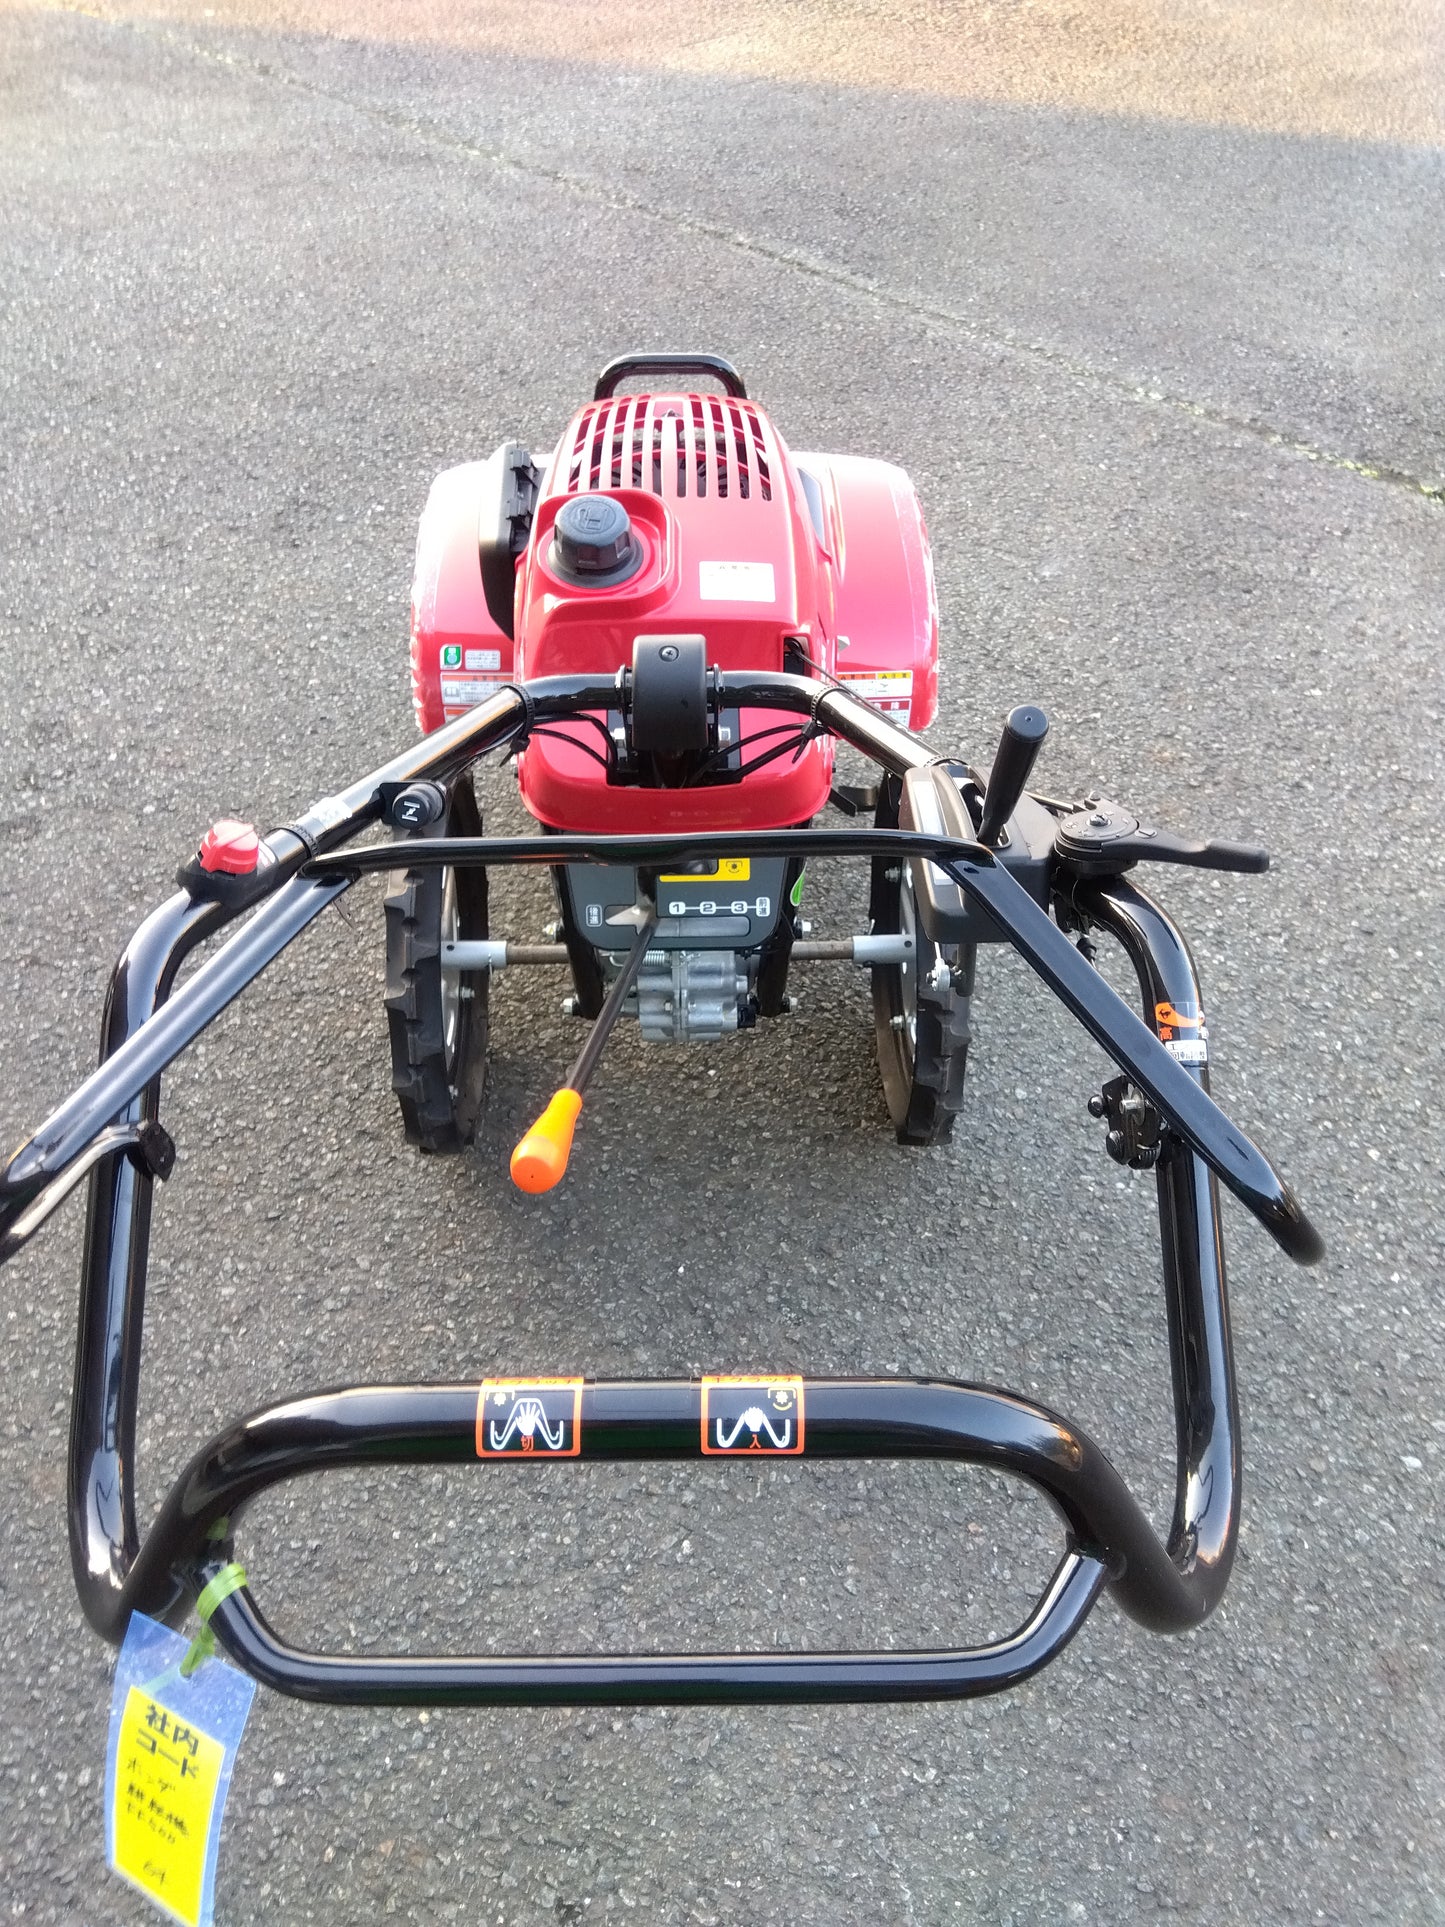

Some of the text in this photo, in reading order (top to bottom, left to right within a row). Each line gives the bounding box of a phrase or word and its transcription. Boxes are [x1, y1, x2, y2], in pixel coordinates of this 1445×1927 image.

[702, 903, 713, 912] 2
[734, 903, 744, 912] 3
[521, 1435, 534, 1452] 切
[749, 1434, 761, 1449] 入
[145, 1703, 200, 1757] 社内
[136, 1728, 200, 1779] コード
